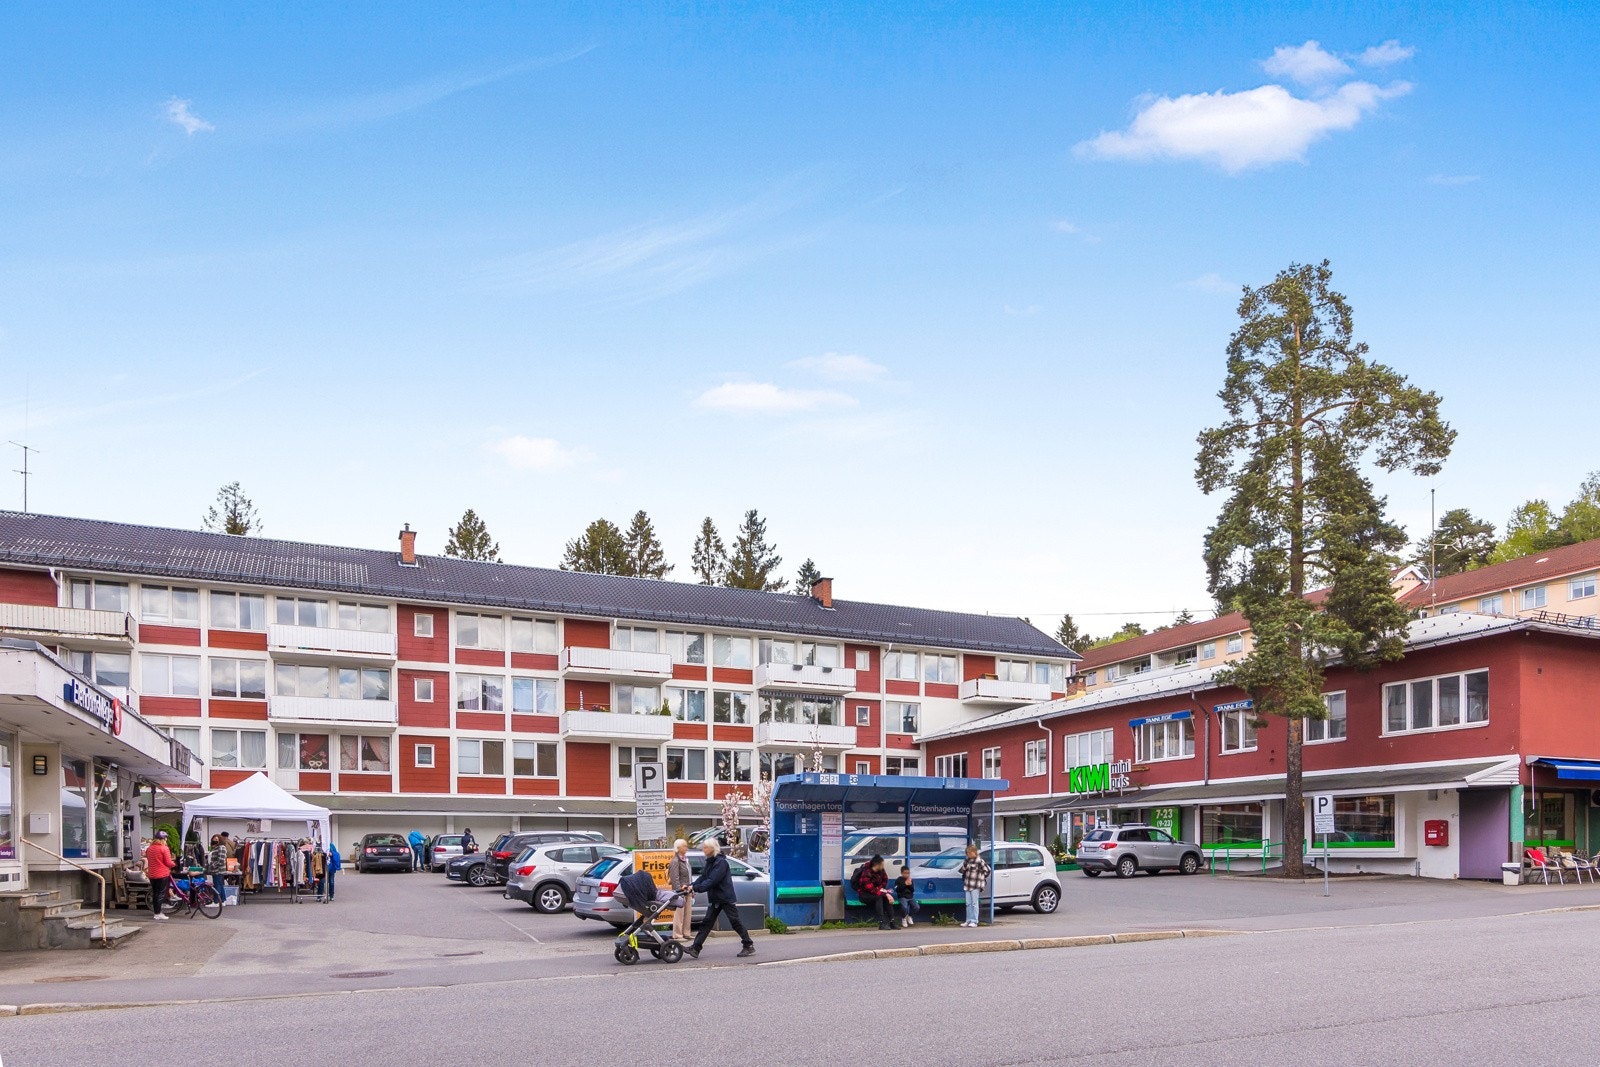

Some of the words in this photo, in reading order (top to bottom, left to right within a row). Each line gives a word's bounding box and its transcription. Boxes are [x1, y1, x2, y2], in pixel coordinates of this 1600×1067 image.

[1217, 702, 1249, 711] TANNLEGE
[1145, 715, 1172, 724] TANNLEGE
[1110, 759, 1129, 774] mini
[642, 767, 656, 788] P
[820, 775, 829, 783] 25
[1069, 762, 1111, 794] KIWI
[1110, 775, 1128, 790] pris
[776, 801, 826, 811] Tonsenhagen
[827, 803, 842, 811] torg
[911, 804, 956, 814] Tonsenhagen
[956, 806, 970, 814] torg
[1319, 797, 1328, 813] P
[1156, 809, 1173, 819] 7-23
